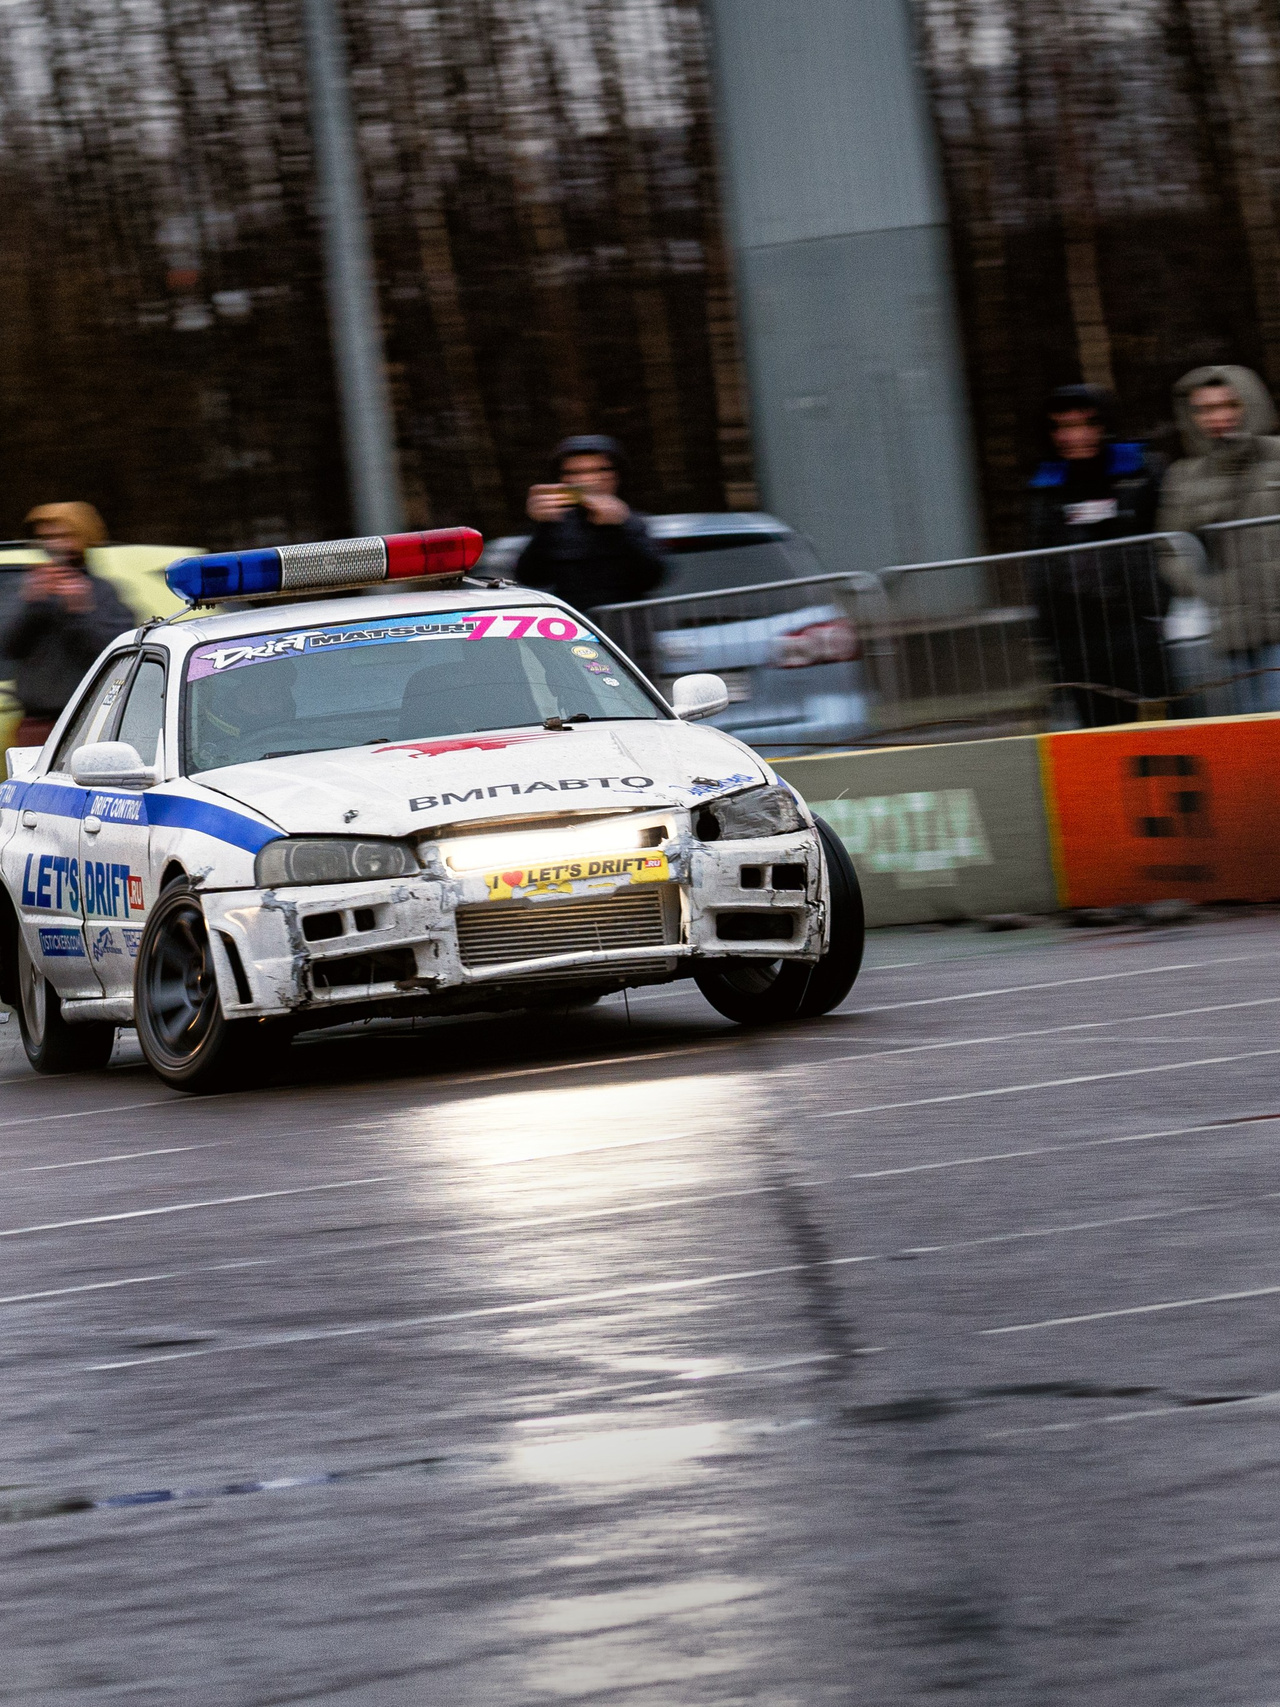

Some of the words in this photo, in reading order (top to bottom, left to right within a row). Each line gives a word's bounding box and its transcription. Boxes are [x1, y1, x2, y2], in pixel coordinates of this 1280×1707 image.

[309, 621, 475, 647] MATSURI
[461, 615, 578, 641] 770
[90, 795, 114, 817] DRIFT
[109, 798, 143, 820] CONTROL
[409, 776, 655, 812] ВМПАВТО
[22, 853, 80, 912] LET'S
[492, 873, 499, 890] I
[526, 864, 582, 885] LET'S
